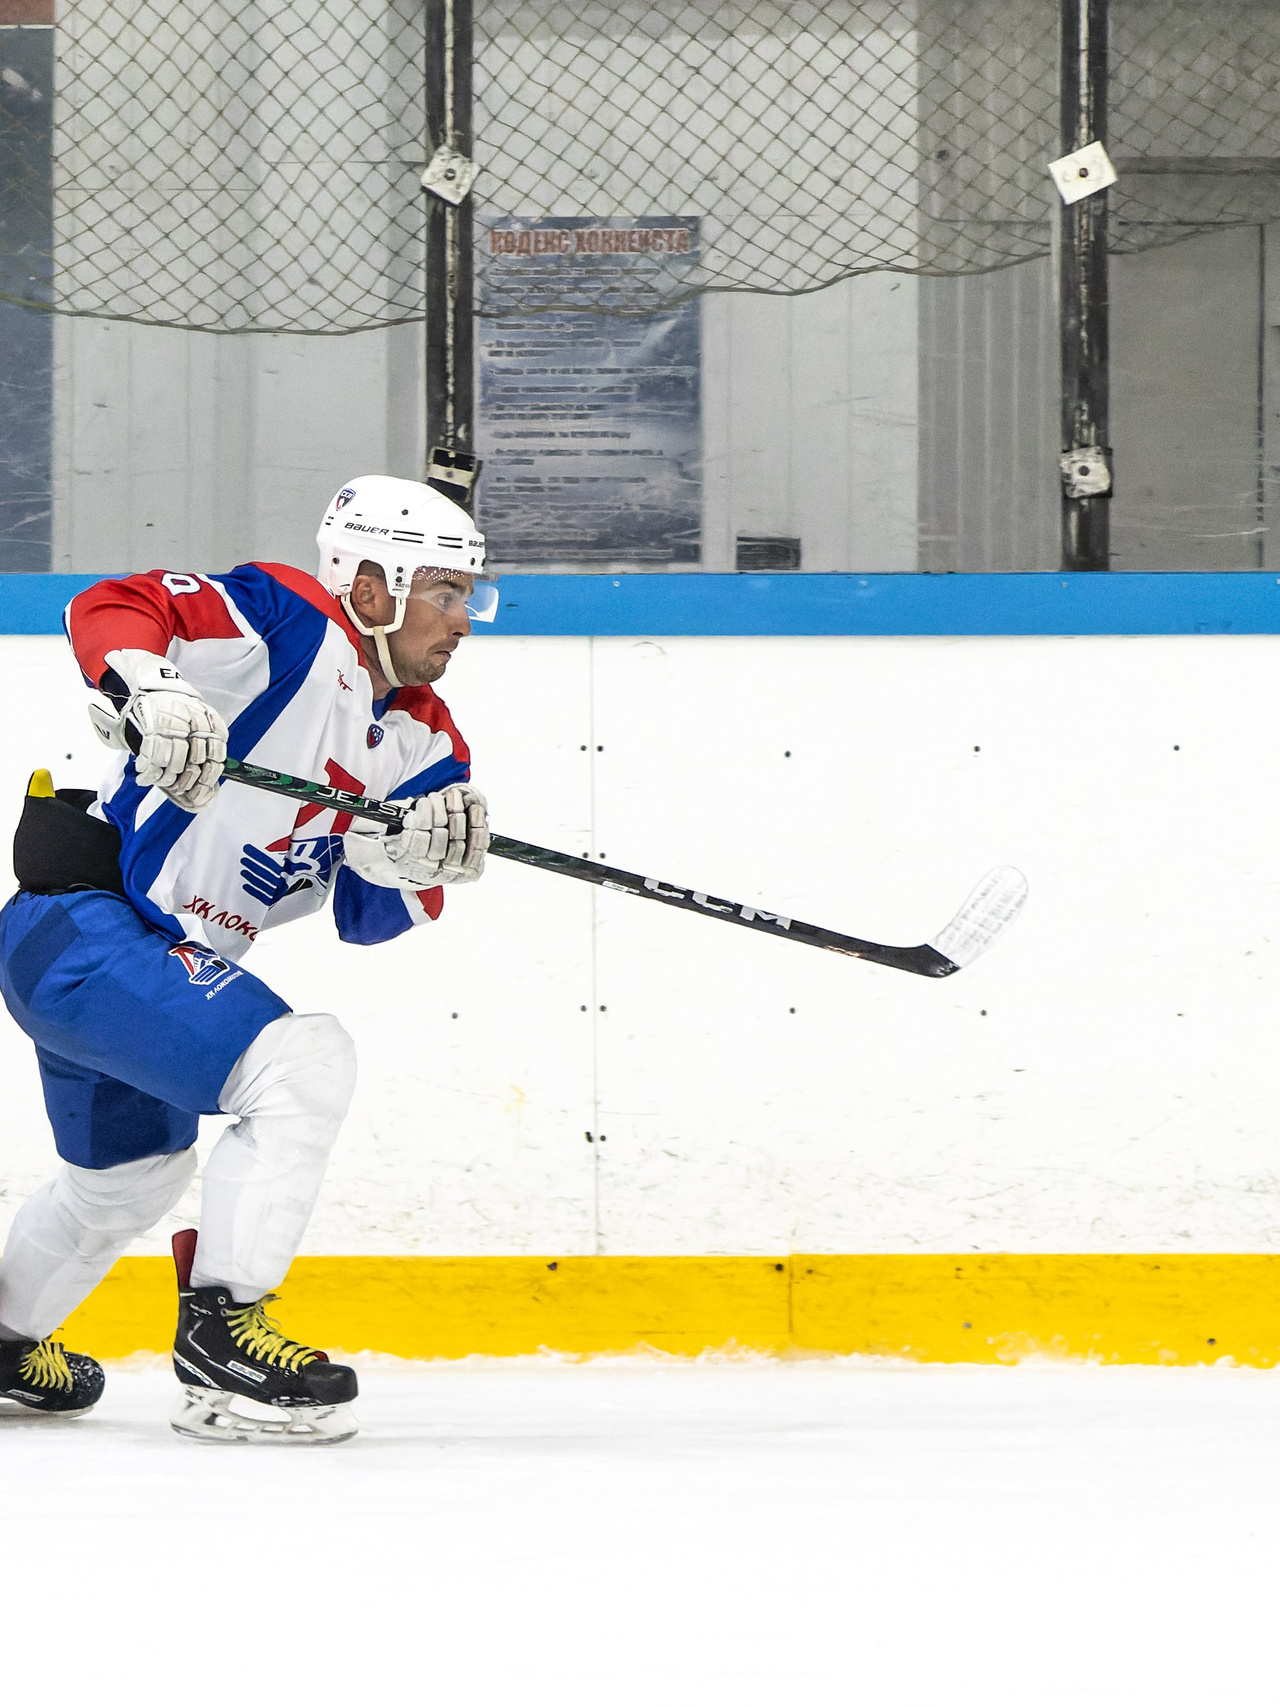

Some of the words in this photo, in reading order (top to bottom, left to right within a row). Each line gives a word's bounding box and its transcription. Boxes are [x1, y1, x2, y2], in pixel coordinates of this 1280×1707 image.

[343, 521, 390, 537] BAUER
[315, 785, 411, 819] JETSP
[182, 894, 216, 920] ХК
[643, 876, 793, 931] CCM
